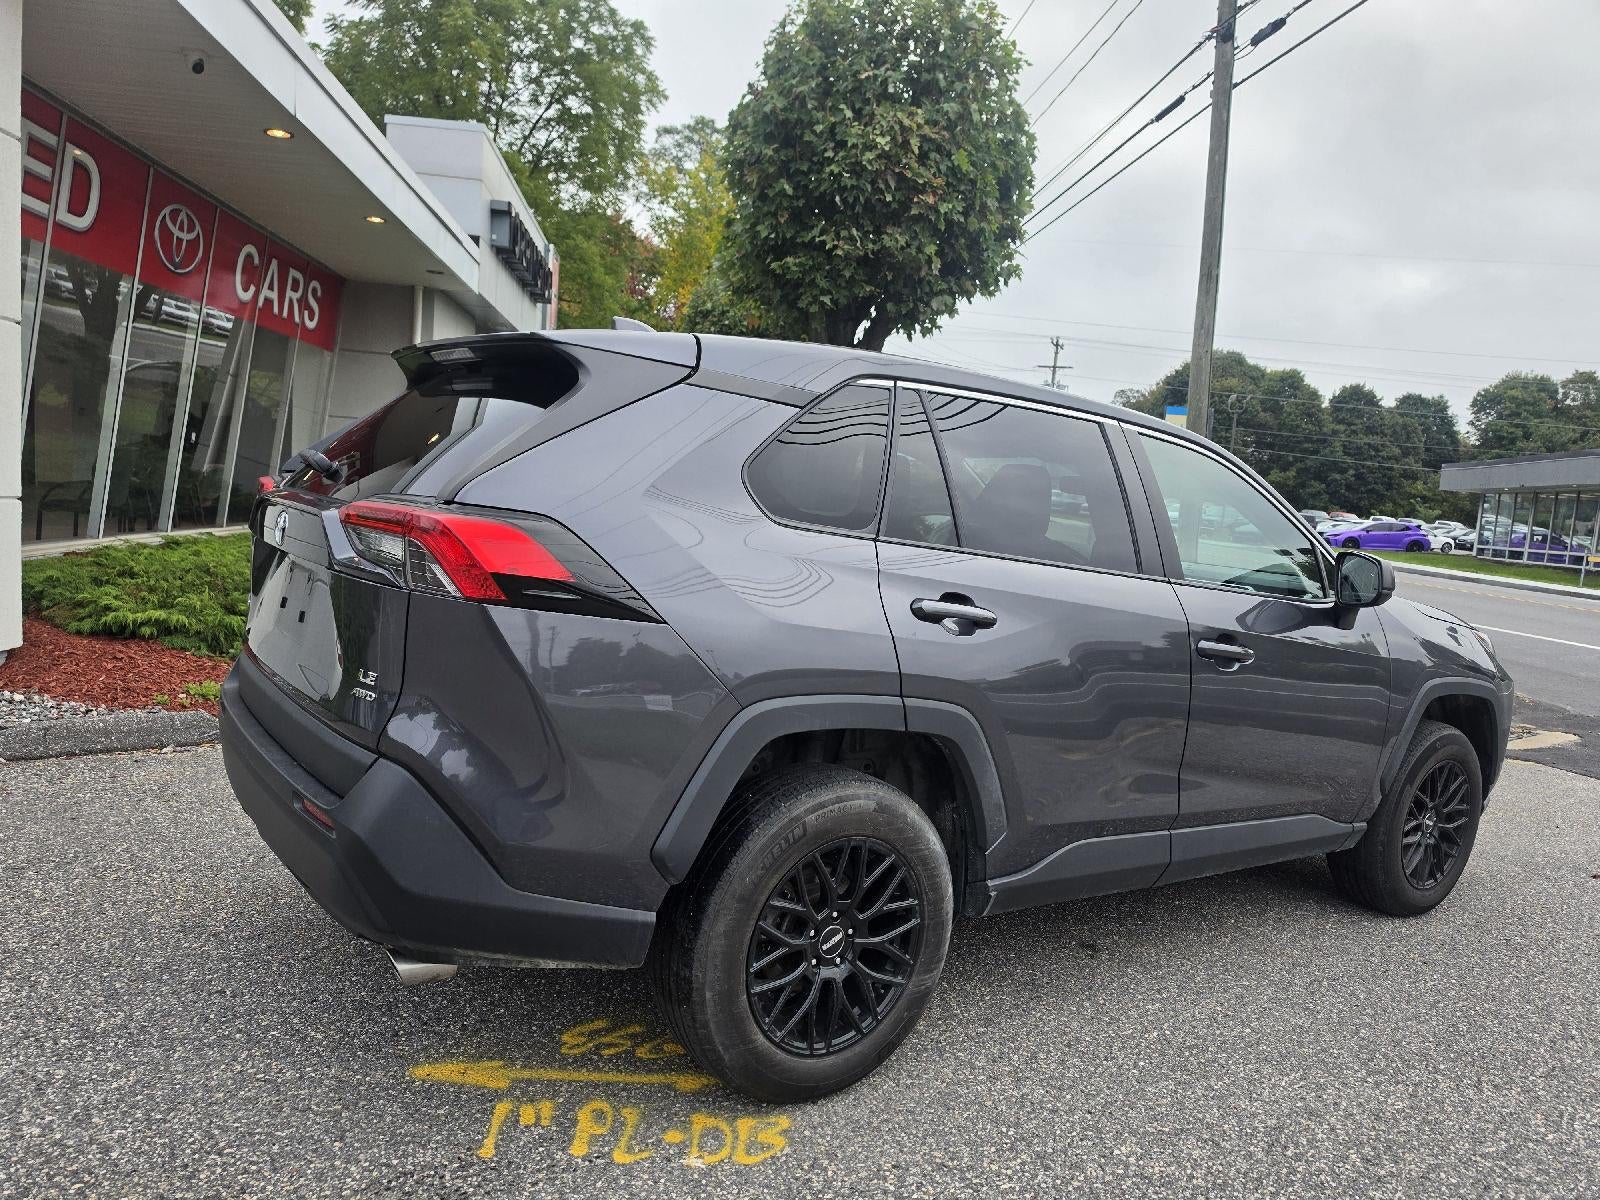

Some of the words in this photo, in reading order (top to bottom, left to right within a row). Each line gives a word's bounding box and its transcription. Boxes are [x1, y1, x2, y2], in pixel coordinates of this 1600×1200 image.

[235, 243, 322, 331] CARS
[359, 668, 378, 686] LE
[350, 687, 377, 702] AWD
